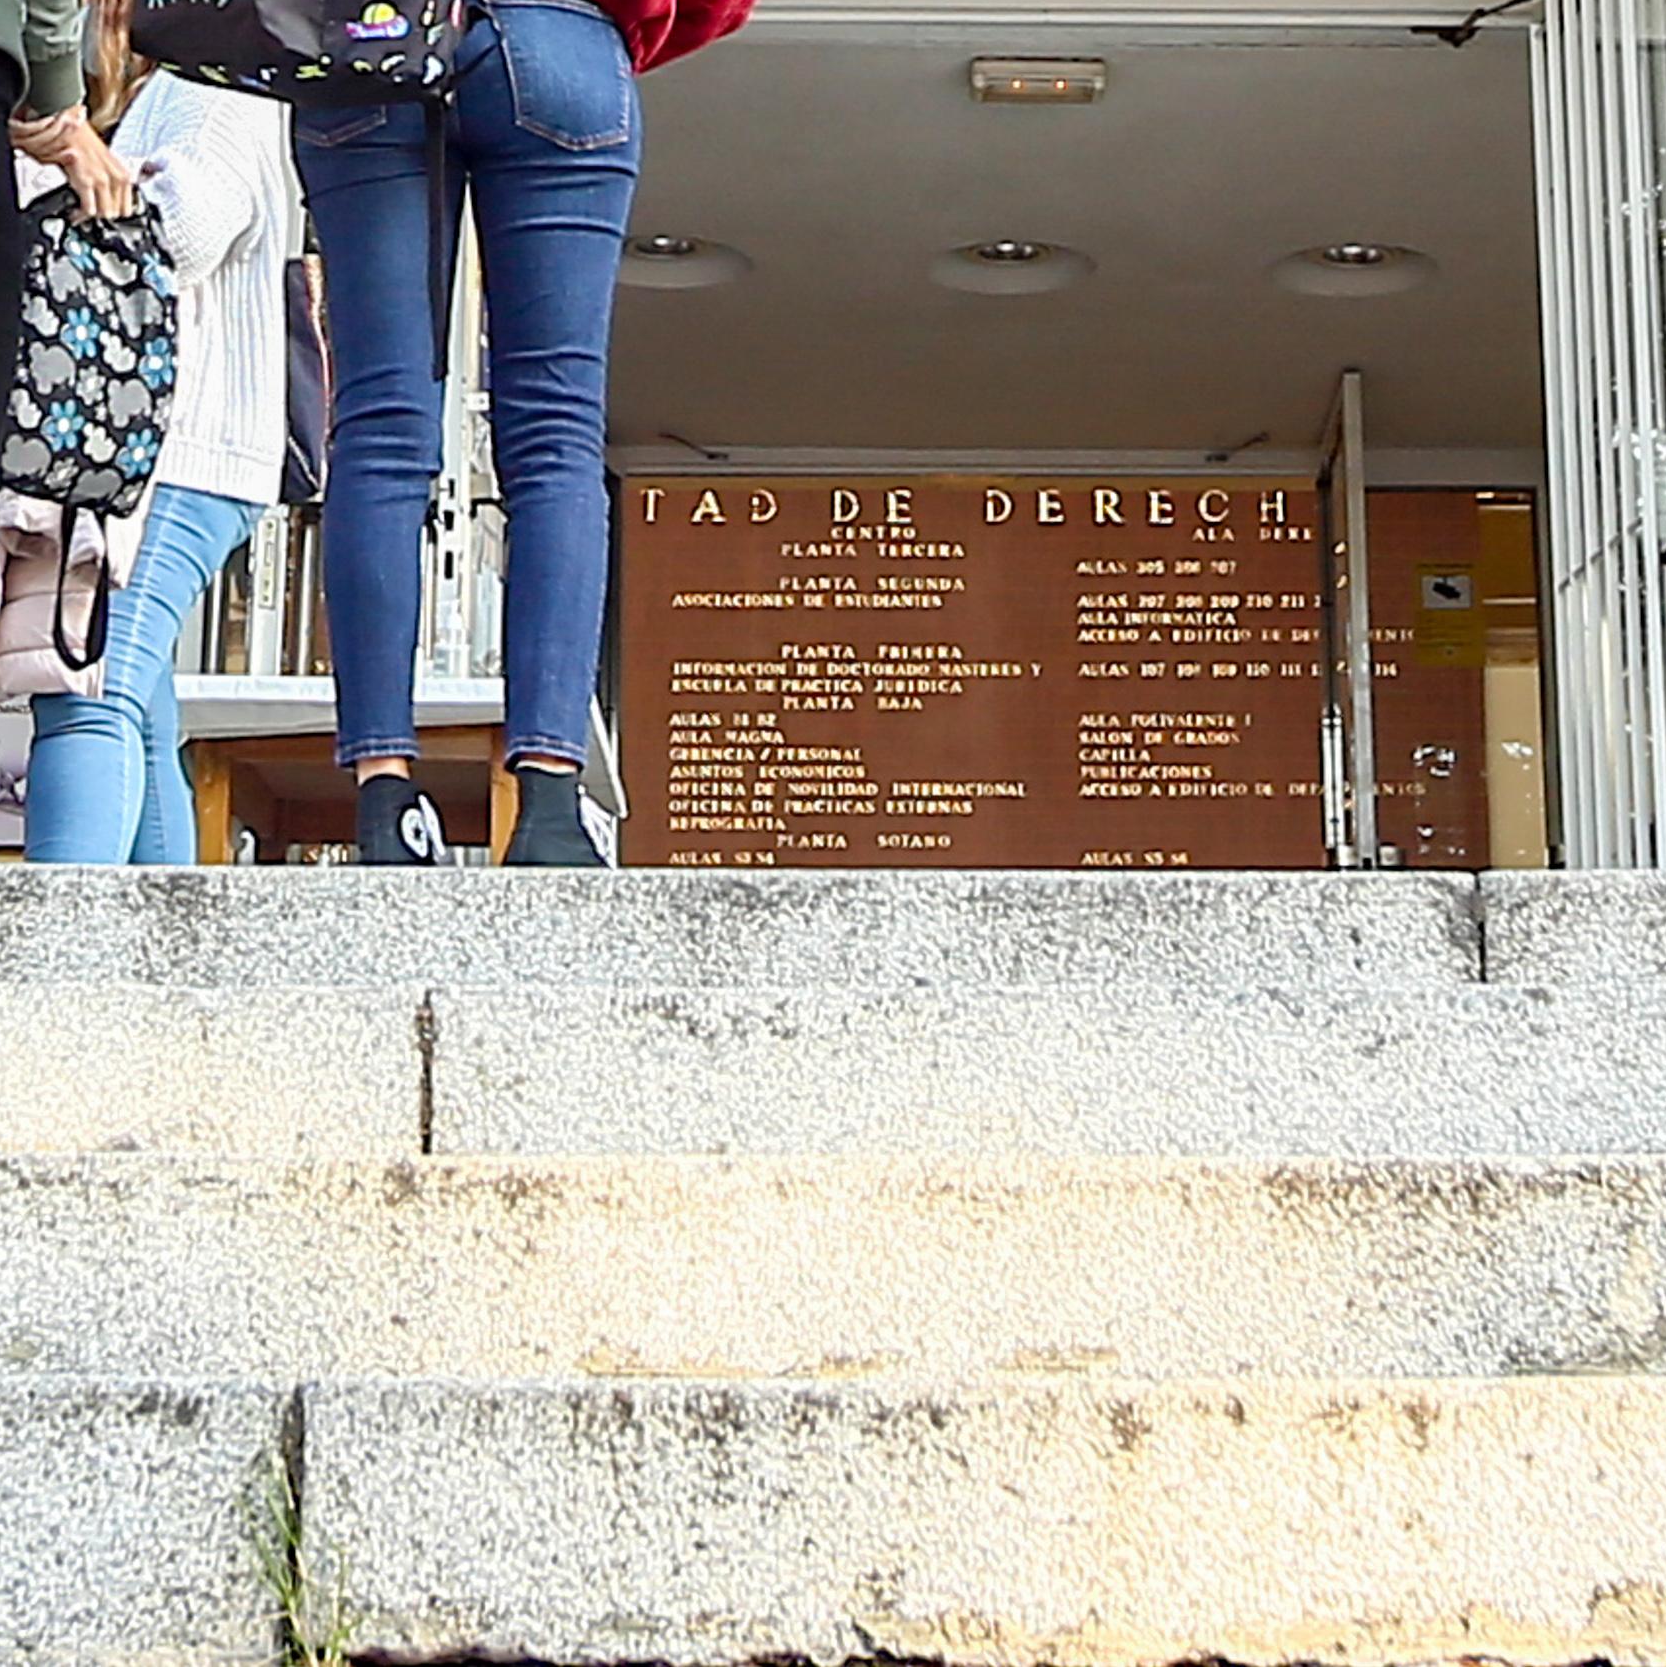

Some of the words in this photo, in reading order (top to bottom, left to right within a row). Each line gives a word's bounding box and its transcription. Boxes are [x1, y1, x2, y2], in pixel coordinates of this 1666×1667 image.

[832, 488, 913, 524] DE
[985, 488, 1286, 524] DERECH
[831, 526, 916, 540] CENTRO
[1192, 527, 1235, 541] ALA
[1259, 527, 1312, 541] DERE
[781, 543, 858, 557] PLANTA
[878, 543, 966, 557] TERCERA
[1076, 560, 1128, 574] AULAS
[779, 577, 858, 591] PLANTA
[877, 577, 966, 591] SEGUNDA
[672, 593, 796, 608] ASOCIACIONES
[802, 593, 825, 608] DE
[834, 593, 943, 608] ESTUDIANTES
[1077, 594, 1129, 609] AULAS
[1077, 612, 1119, 626] AULA
[1124, 612, 1237, 626] INFORMATICA
[1077, 629, 1140, 643] ACCESO
[1148, 629, 1162, 643] A
[1171, 629, 1252, 643] EDIFICIO
[781, 645, 856, 659] PLANTA
[878, 645, 963, 659] PRIMERA
[673, 662, 787, 676] INFORMACION
[796, 662, 818, 676] DE
[826, 662, 931, 676] DOCTORADO
[938, 662, 1023, 676] MASTERES
[1031, 662, 1042, 676] Y
[1077, 662, 1130, 677] AULAS
[671, 679, 748, 694] ESCUELA
[754, 679, 776, 694] DE
[781, 679, 864, 694] PRACTICA
[873, 679, 963, 694] JURIDICA
[782, 696, 855, 711] PLANTA
[877, 696, 924, 711] BAJA
[669, 712, 722, 727] AULAS
[1077, 713, 1122, 728] AULA
[669, 730, 713, 745] AULA
[724, 730, 785, 745] MAGNA
[1078, 731, 1134, 745] SALON
[1172, 731, 1241, 745] GRADOS
[669, 747, 756, 762] GERENCIA
[777, 747, 862, 762] PERSONAL
[1078, 748, 1151, 763] CAPILLA
[669, 765, 745, 779] ASUNTOS
[759, 765, 866, 779] ECONOMICOS
[1080, 765, 1214, 780] PUBLICACIONES
[669, 782, 747, 796] OFICINA
[753, 782, 775, 796] DE
[787, 782, 879, 796] MOVILIDAD
[891, 782, 1027, 796] INTERNACIONAL
[1078, 783, 1143, 797] ACCESO
[1149, 783, 1162, 797] A
[1167, 783, 1248, 797] EDIFICIO
[669, 800, 747, 814] OFICINA
[750, 800, 774, 814] DE
[783, 800, 876, 814] PRACTICAS
[884, 800, 974, 814] EXTERNAS
[669, 817, 787, 831] REPROGRAFIA
[777, 834, 848, 849] PLANTA
[877, 834, 952, 849] SOTANO
[669, 851, 722, 866] AULAS
[1080, 851, 1133, 866] AULAS
